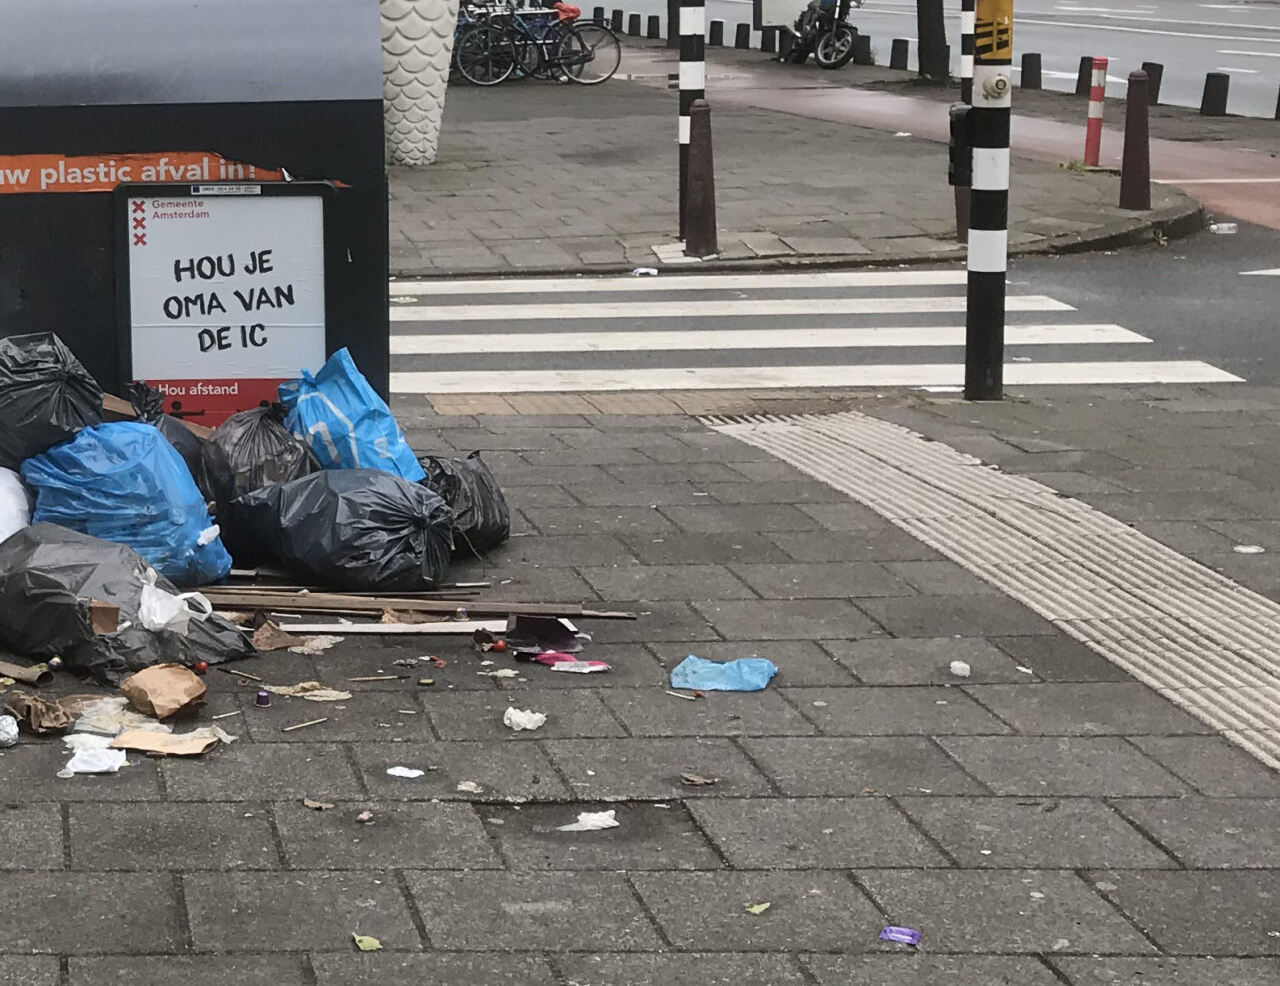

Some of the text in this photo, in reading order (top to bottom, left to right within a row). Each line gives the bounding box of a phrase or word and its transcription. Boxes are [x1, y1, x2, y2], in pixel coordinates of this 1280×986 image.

[40, 160, 132, 190] plastic
[141, 157, 209, 181] afval
[152, 200, 204, 209] Gemeente
[152, 210, 210, 219] Amsterdam
[174, 249, 273, 283] HOU JE
[163, 284, 295, 320] OMA VAN
[198, 323, 268, 353] DE IC
[158, 382, 239, 396] Hou afstand
